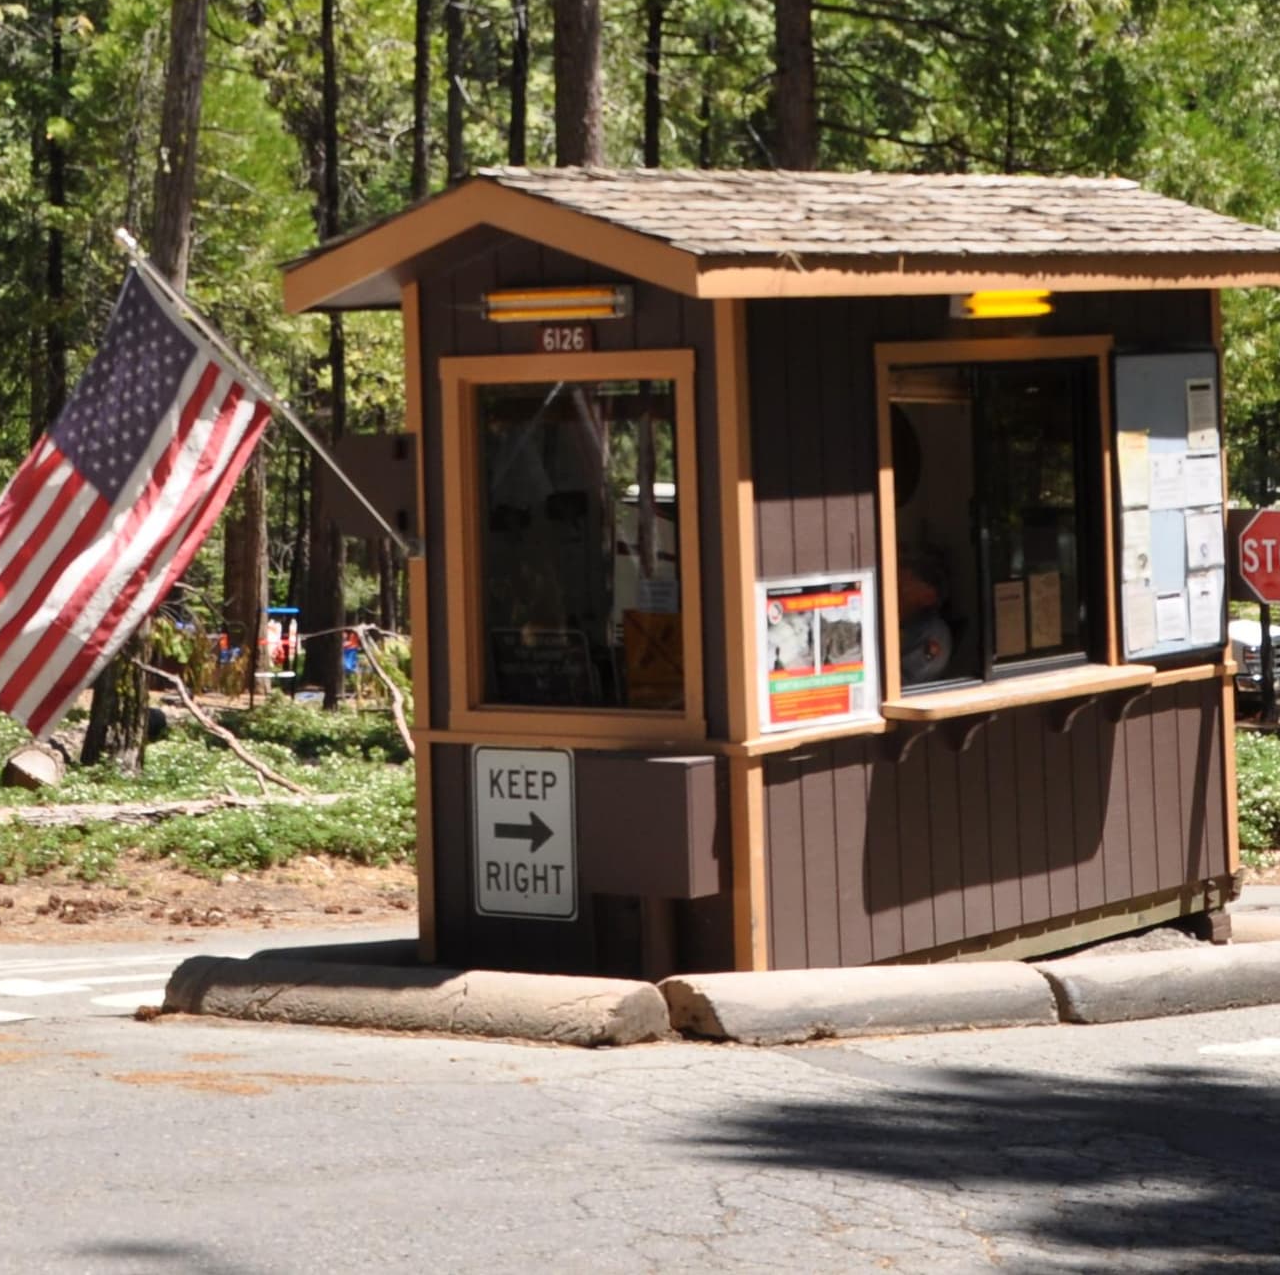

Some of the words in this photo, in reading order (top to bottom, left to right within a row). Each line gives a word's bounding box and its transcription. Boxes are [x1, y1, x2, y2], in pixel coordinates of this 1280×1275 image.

[543, 326, 585, 351] 6126
[489, 768, 557, 801] KEEP
[486, 861, 565, 895] RIGHT
